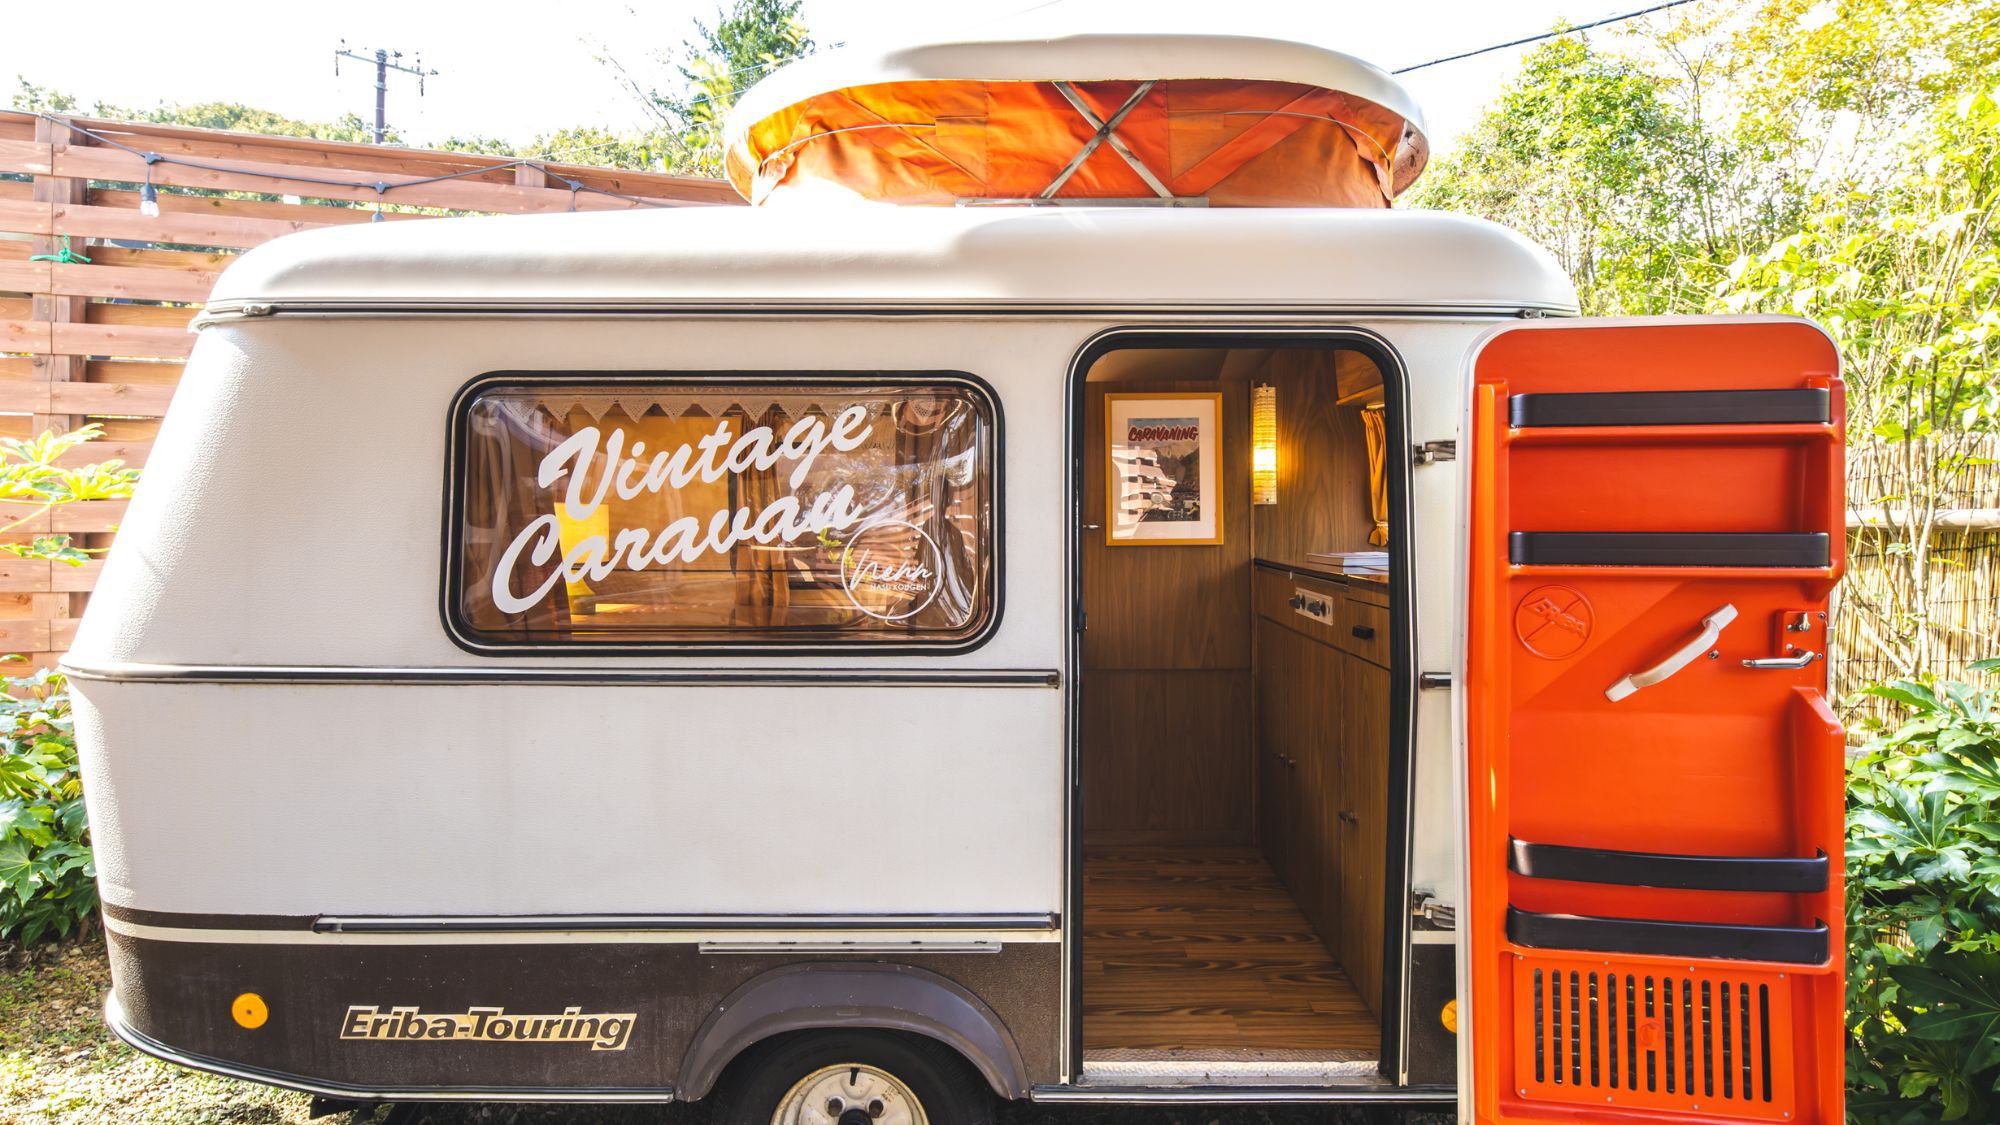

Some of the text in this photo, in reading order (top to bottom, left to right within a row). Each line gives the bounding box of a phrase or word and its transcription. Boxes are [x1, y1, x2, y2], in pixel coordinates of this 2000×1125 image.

[538, 405, 873, 521] Vintage
[1127, 427, 1198, 441] CARAVANING
[492, 485, 864, 614] Caravan
[342, 1007, 635, 1049] Eriba-Touring
